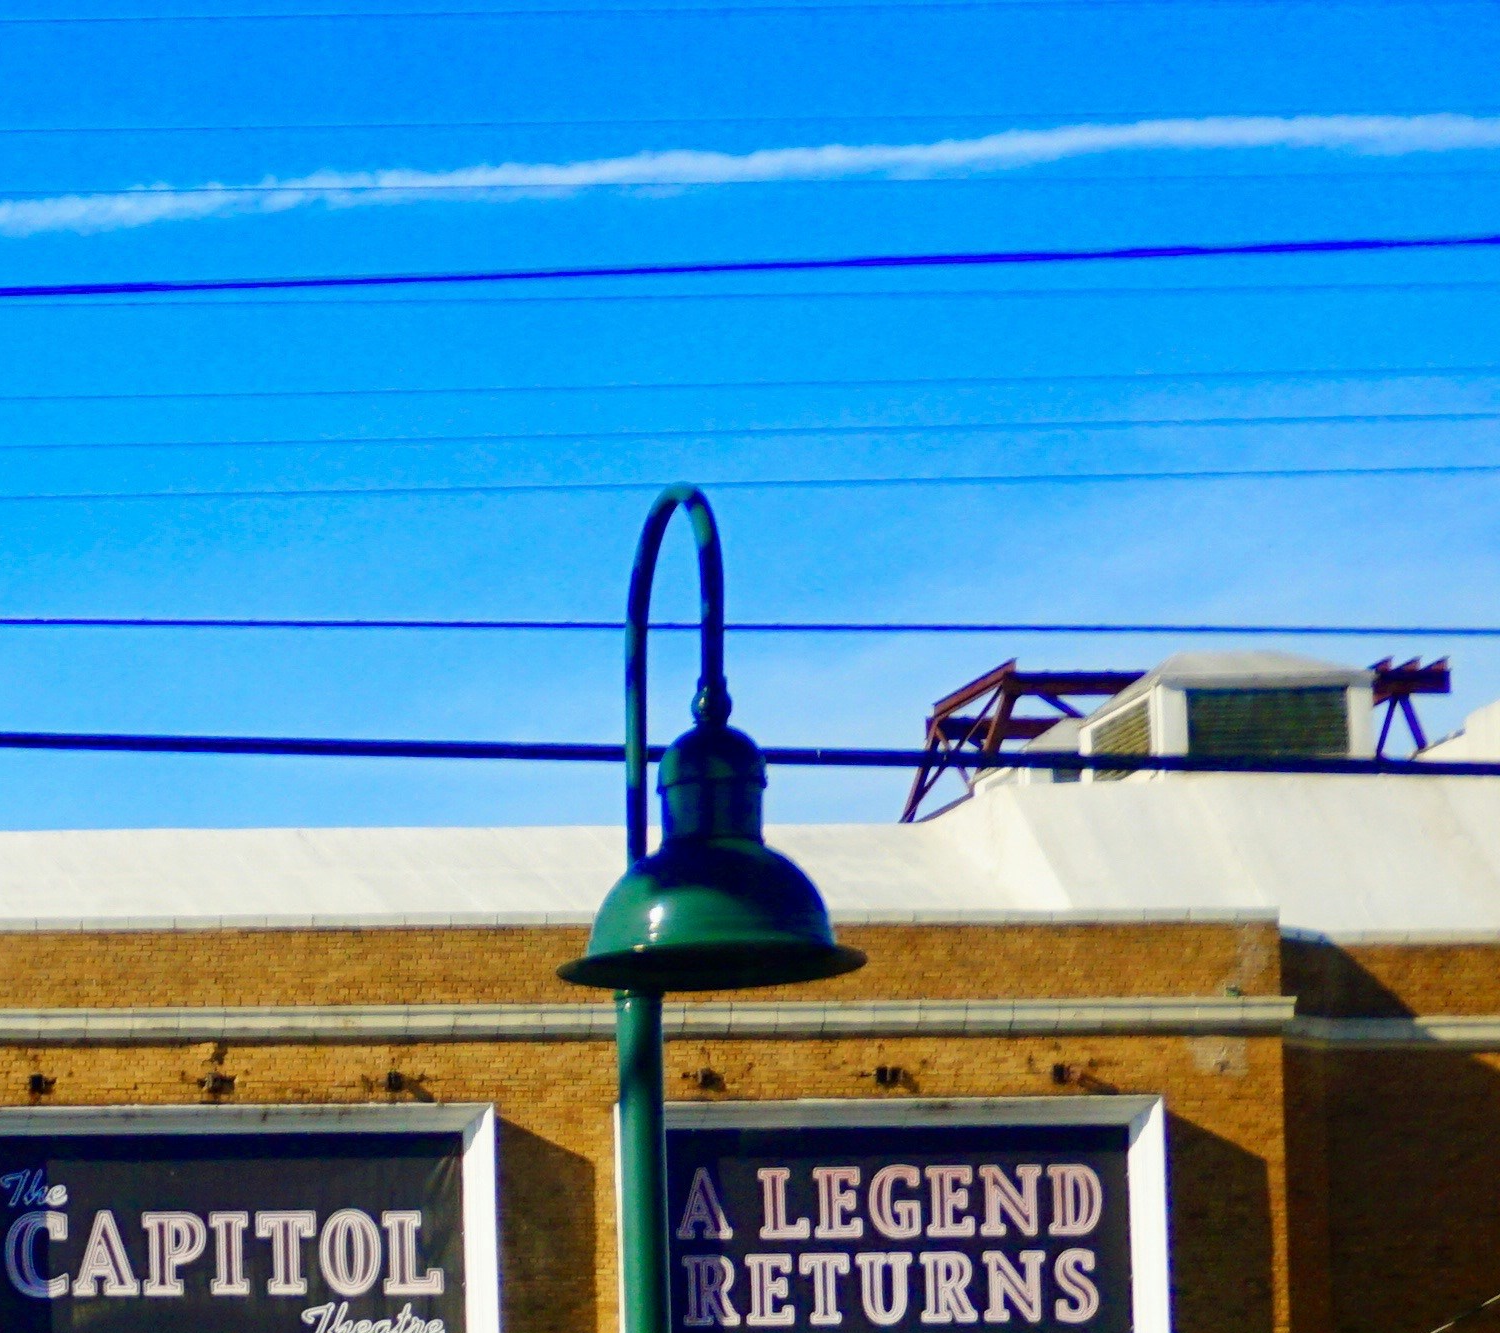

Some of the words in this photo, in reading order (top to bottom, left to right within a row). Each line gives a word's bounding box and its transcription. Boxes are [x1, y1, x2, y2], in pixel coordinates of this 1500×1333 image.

[0, 1168, 68, 1208] The
[675, 1166, 734, 1240] A
[756, 1163, 1103, 1241] LEGEND
[4, 1208, 445, 1298] CAPITOL
[680, 1247, 1100, 1327] RETURNS
